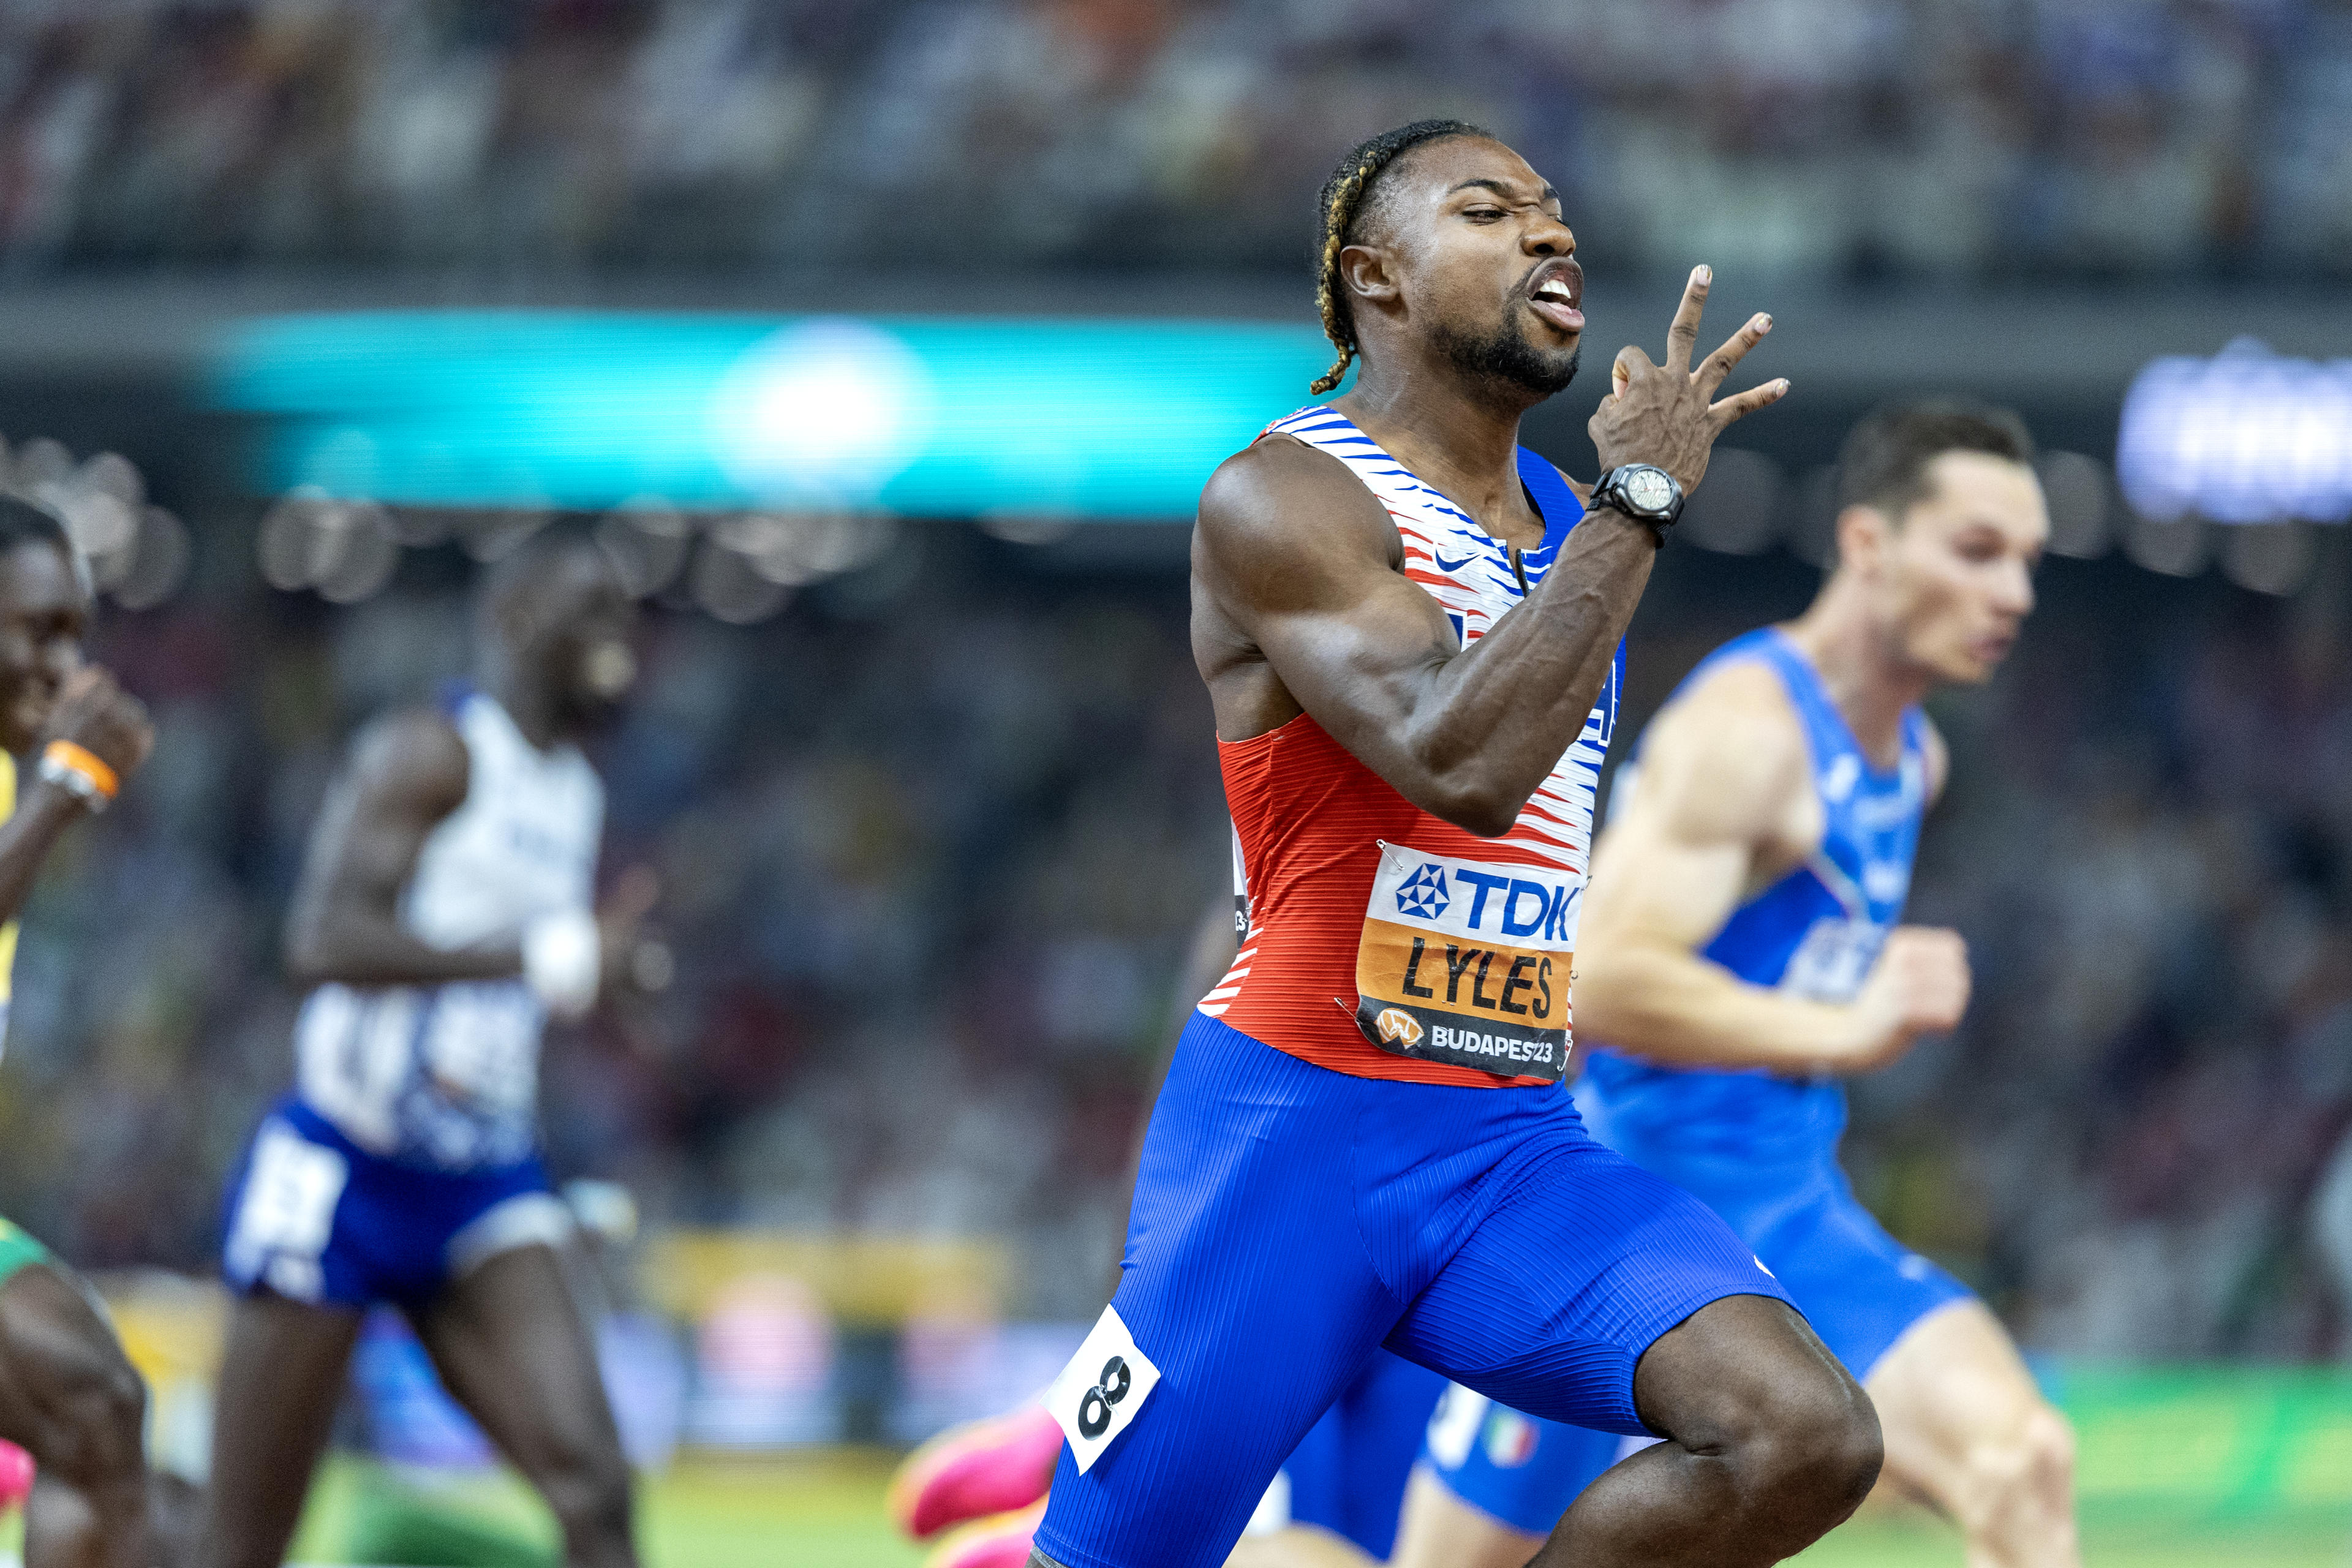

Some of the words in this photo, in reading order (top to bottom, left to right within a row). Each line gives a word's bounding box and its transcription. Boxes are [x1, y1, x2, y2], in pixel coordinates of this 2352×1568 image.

[1455, 869, 1580, 941] TDK
[1402, 937, 1552, 1019] LYLES
[1078, 1355, 1131, 1441] 8
